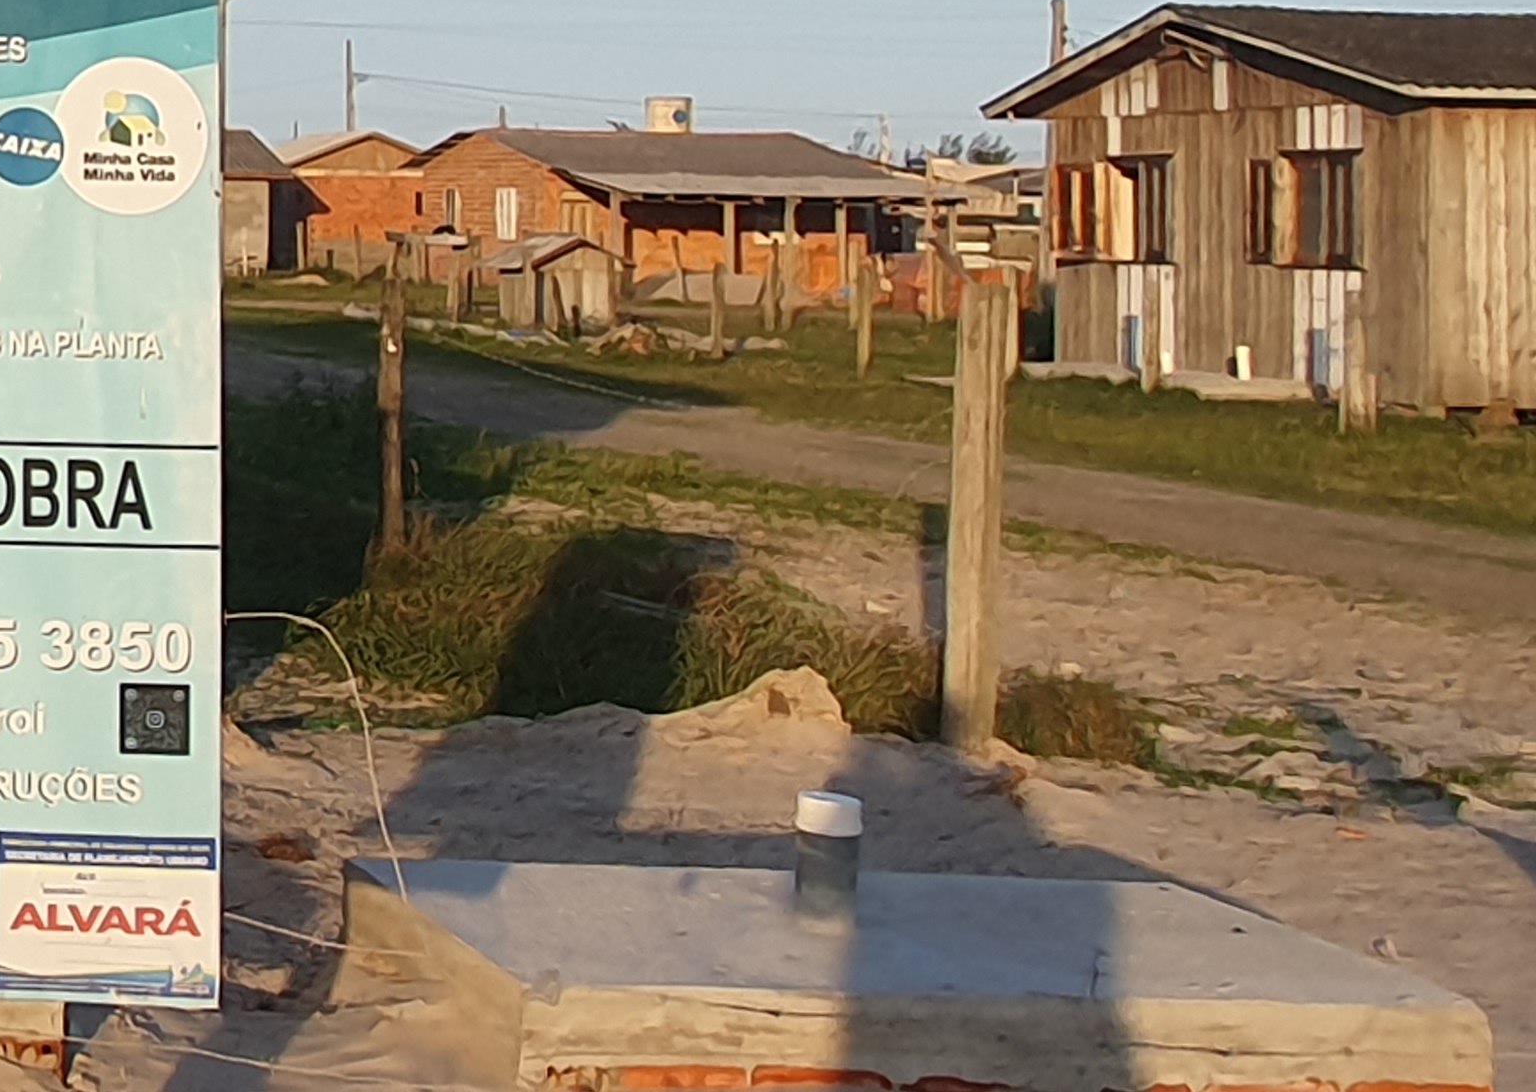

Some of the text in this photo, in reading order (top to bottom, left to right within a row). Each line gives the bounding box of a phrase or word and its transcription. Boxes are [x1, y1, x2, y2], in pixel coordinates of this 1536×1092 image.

[83, 152, 176, 167] Minha Casa
[83, 168, 176, 183] Minha Vida
[9, 330, 47, 357] NA
[55, 331, 164, 361] PLANTA
[40, 621, 192, 673] 3850
[10, 899, 202, 937] ALVARÁ
